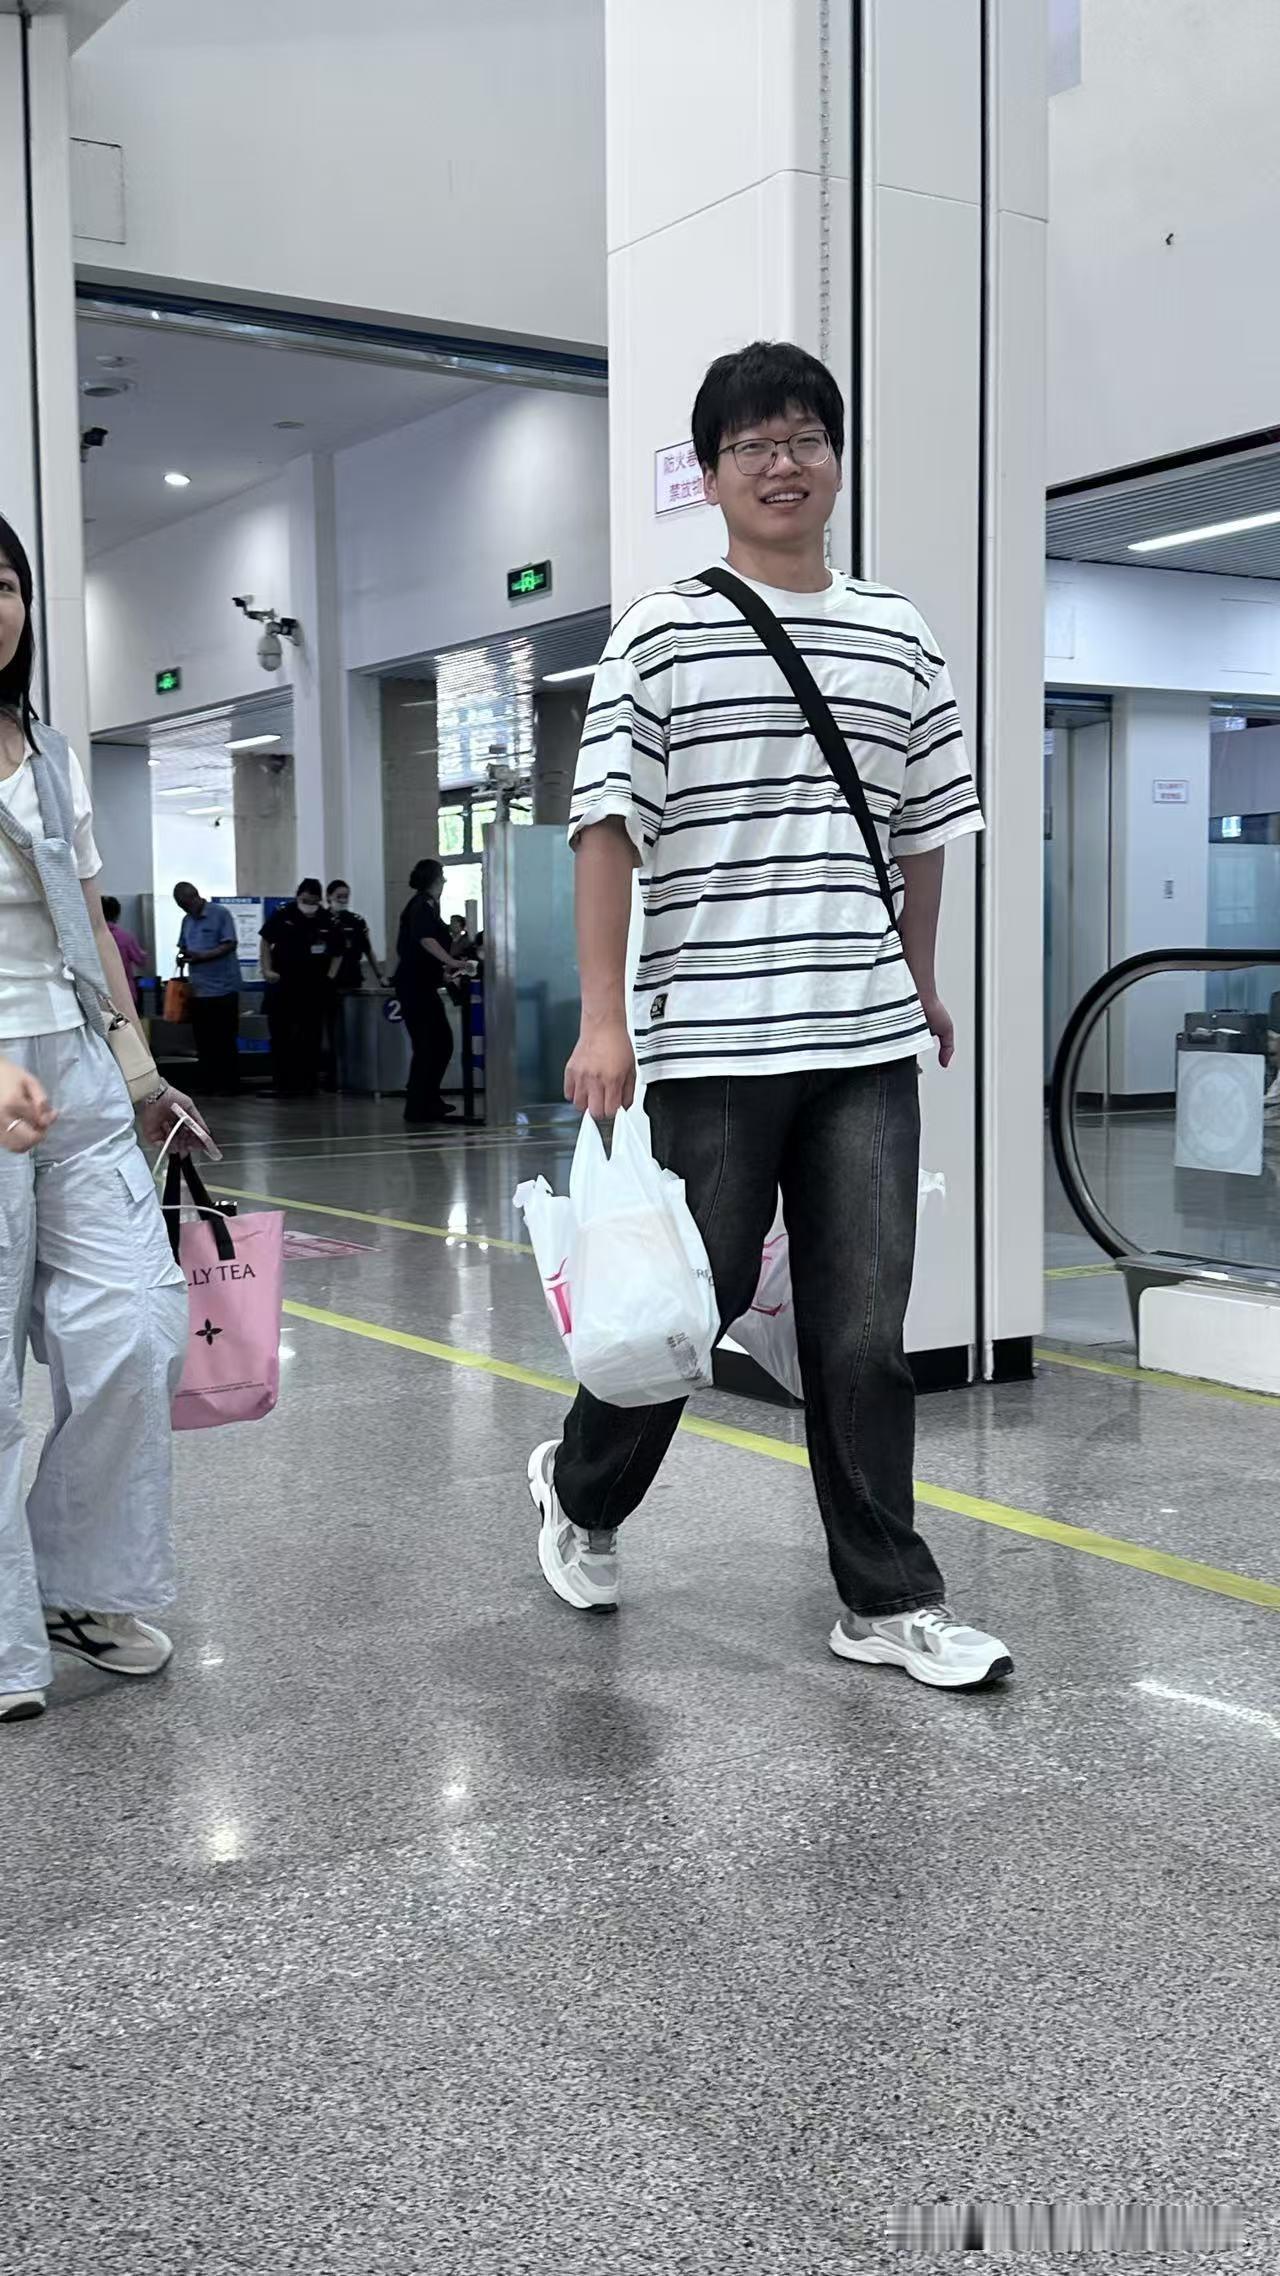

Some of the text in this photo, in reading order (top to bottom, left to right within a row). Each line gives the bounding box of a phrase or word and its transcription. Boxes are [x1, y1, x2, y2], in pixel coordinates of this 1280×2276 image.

[388, 1000, 402, 1020] 2
[187, 1263, 256, 1287] LY TEA
